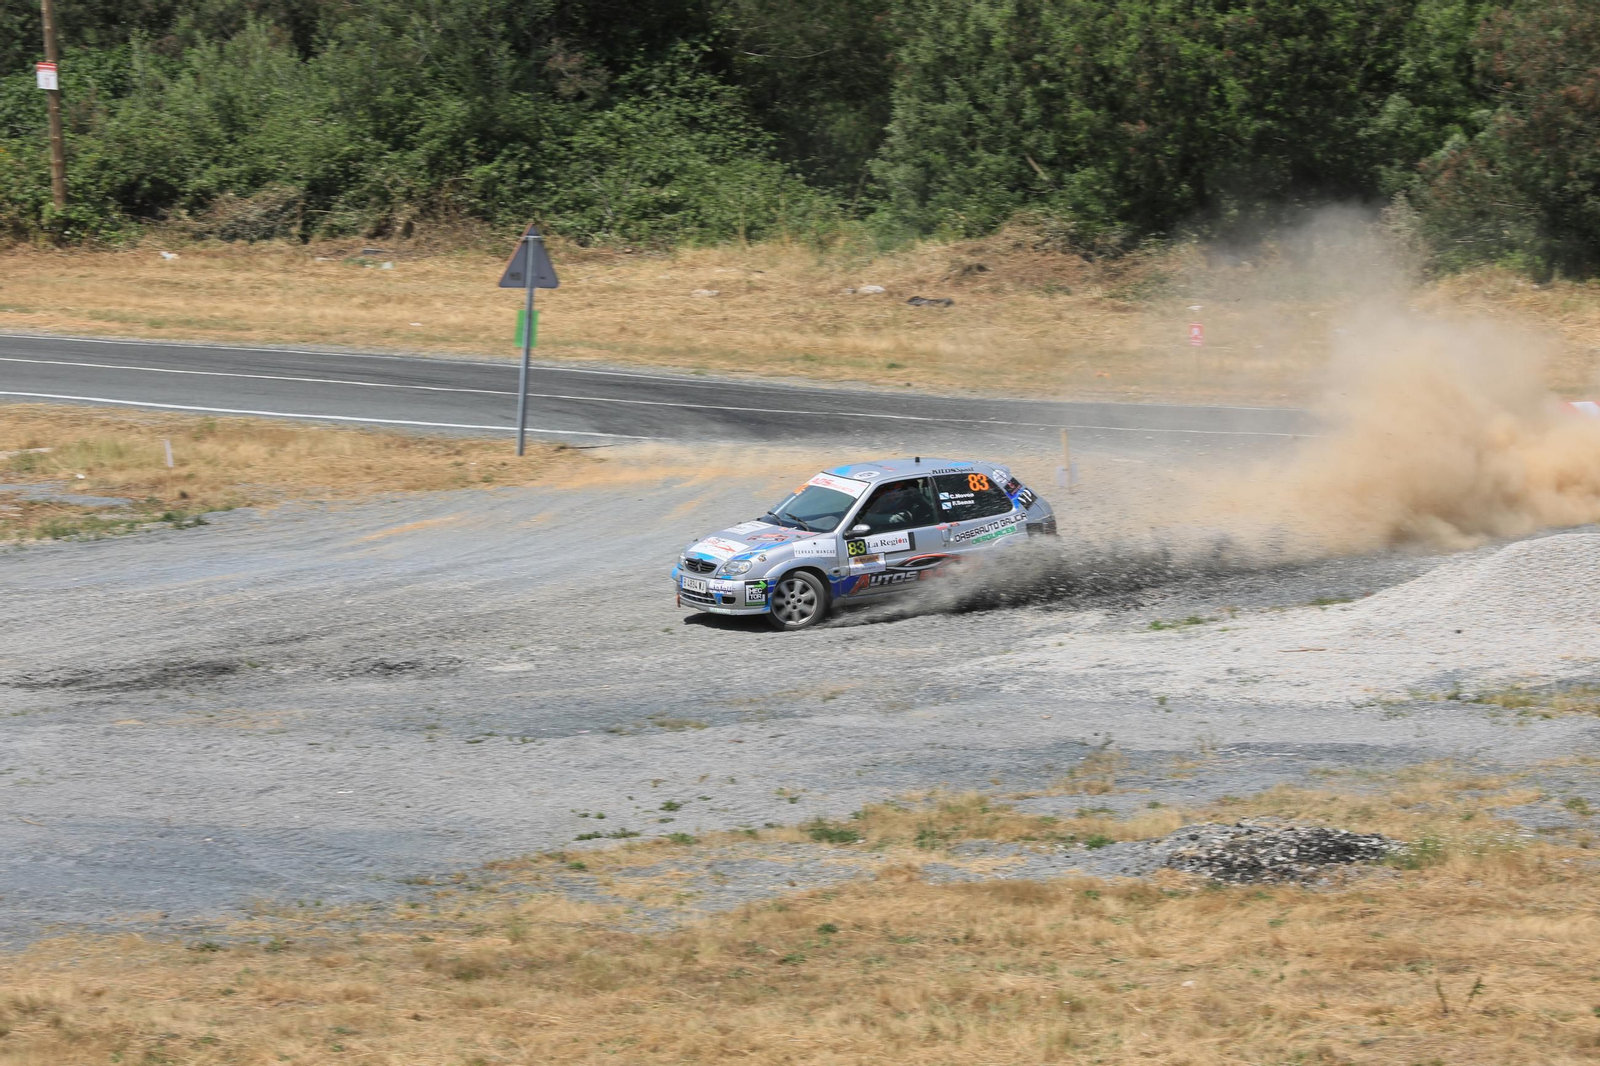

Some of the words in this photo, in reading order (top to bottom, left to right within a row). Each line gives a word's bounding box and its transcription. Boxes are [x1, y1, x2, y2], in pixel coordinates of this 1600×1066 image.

[968, 474, 989, 491] 83
[1001, 512, 1027, 527] GALICIA
[848, 541, 866, 556] 83
